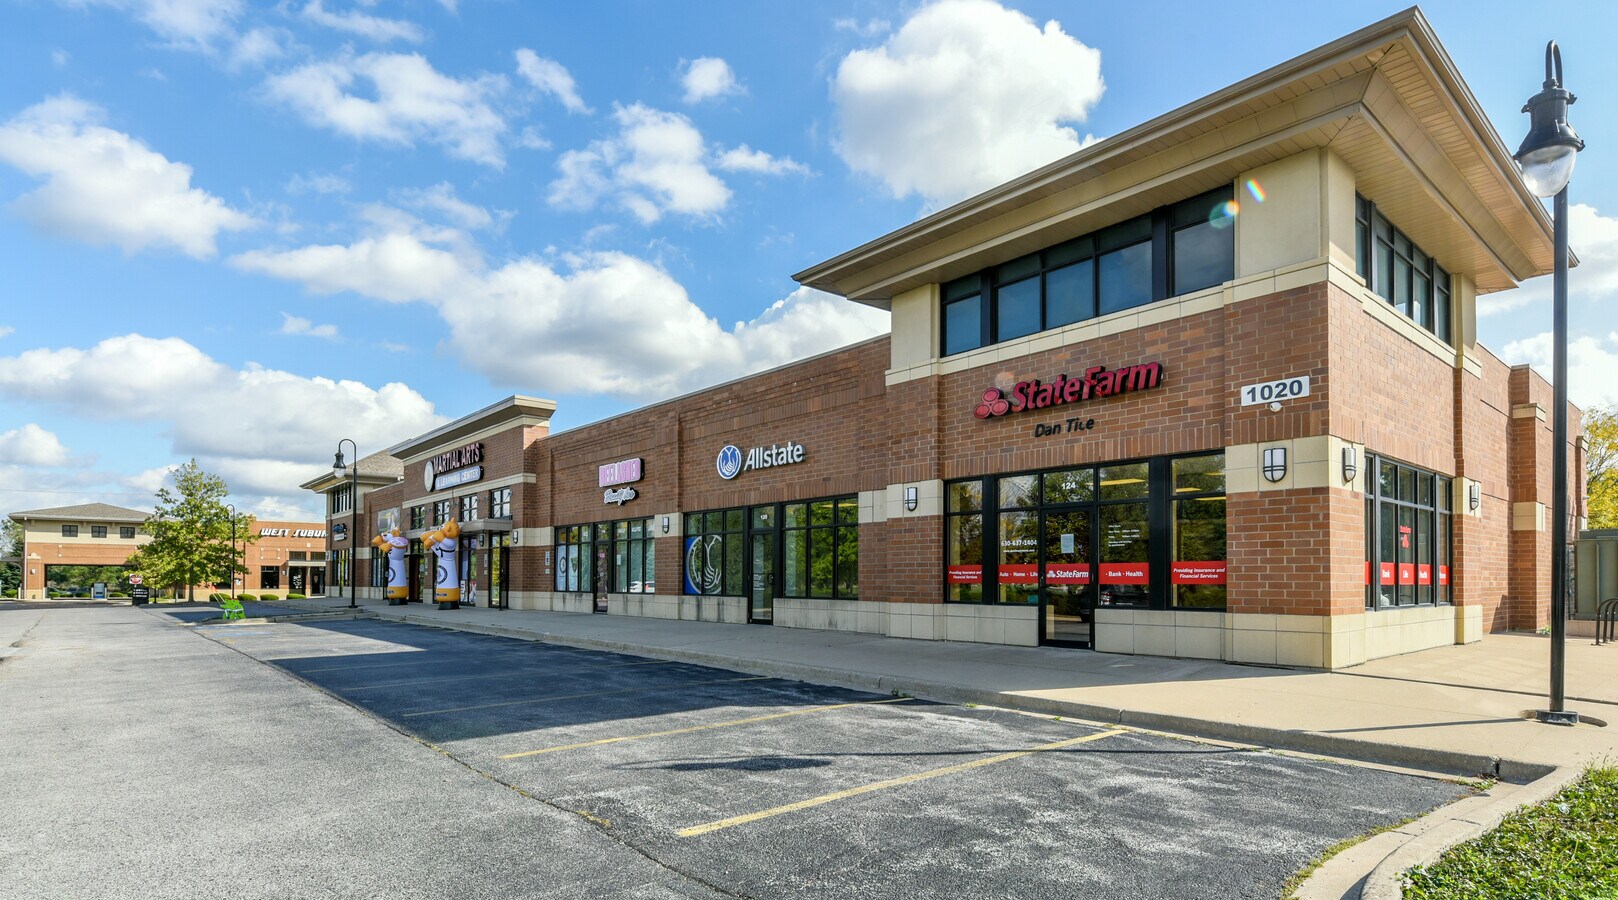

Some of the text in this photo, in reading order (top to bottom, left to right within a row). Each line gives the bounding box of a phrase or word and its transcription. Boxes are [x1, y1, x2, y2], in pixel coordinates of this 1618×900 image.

[1246, 379, 1303, 403] 1020
[1034, 423, 1061, 438] Dan
[433, 442, 481, 475] MARTIAL ARTS
[743, 441, 804, 471] Allstate
[1061, 482, 1077, 490] 124
[260, 528, 290, 536] WEST
